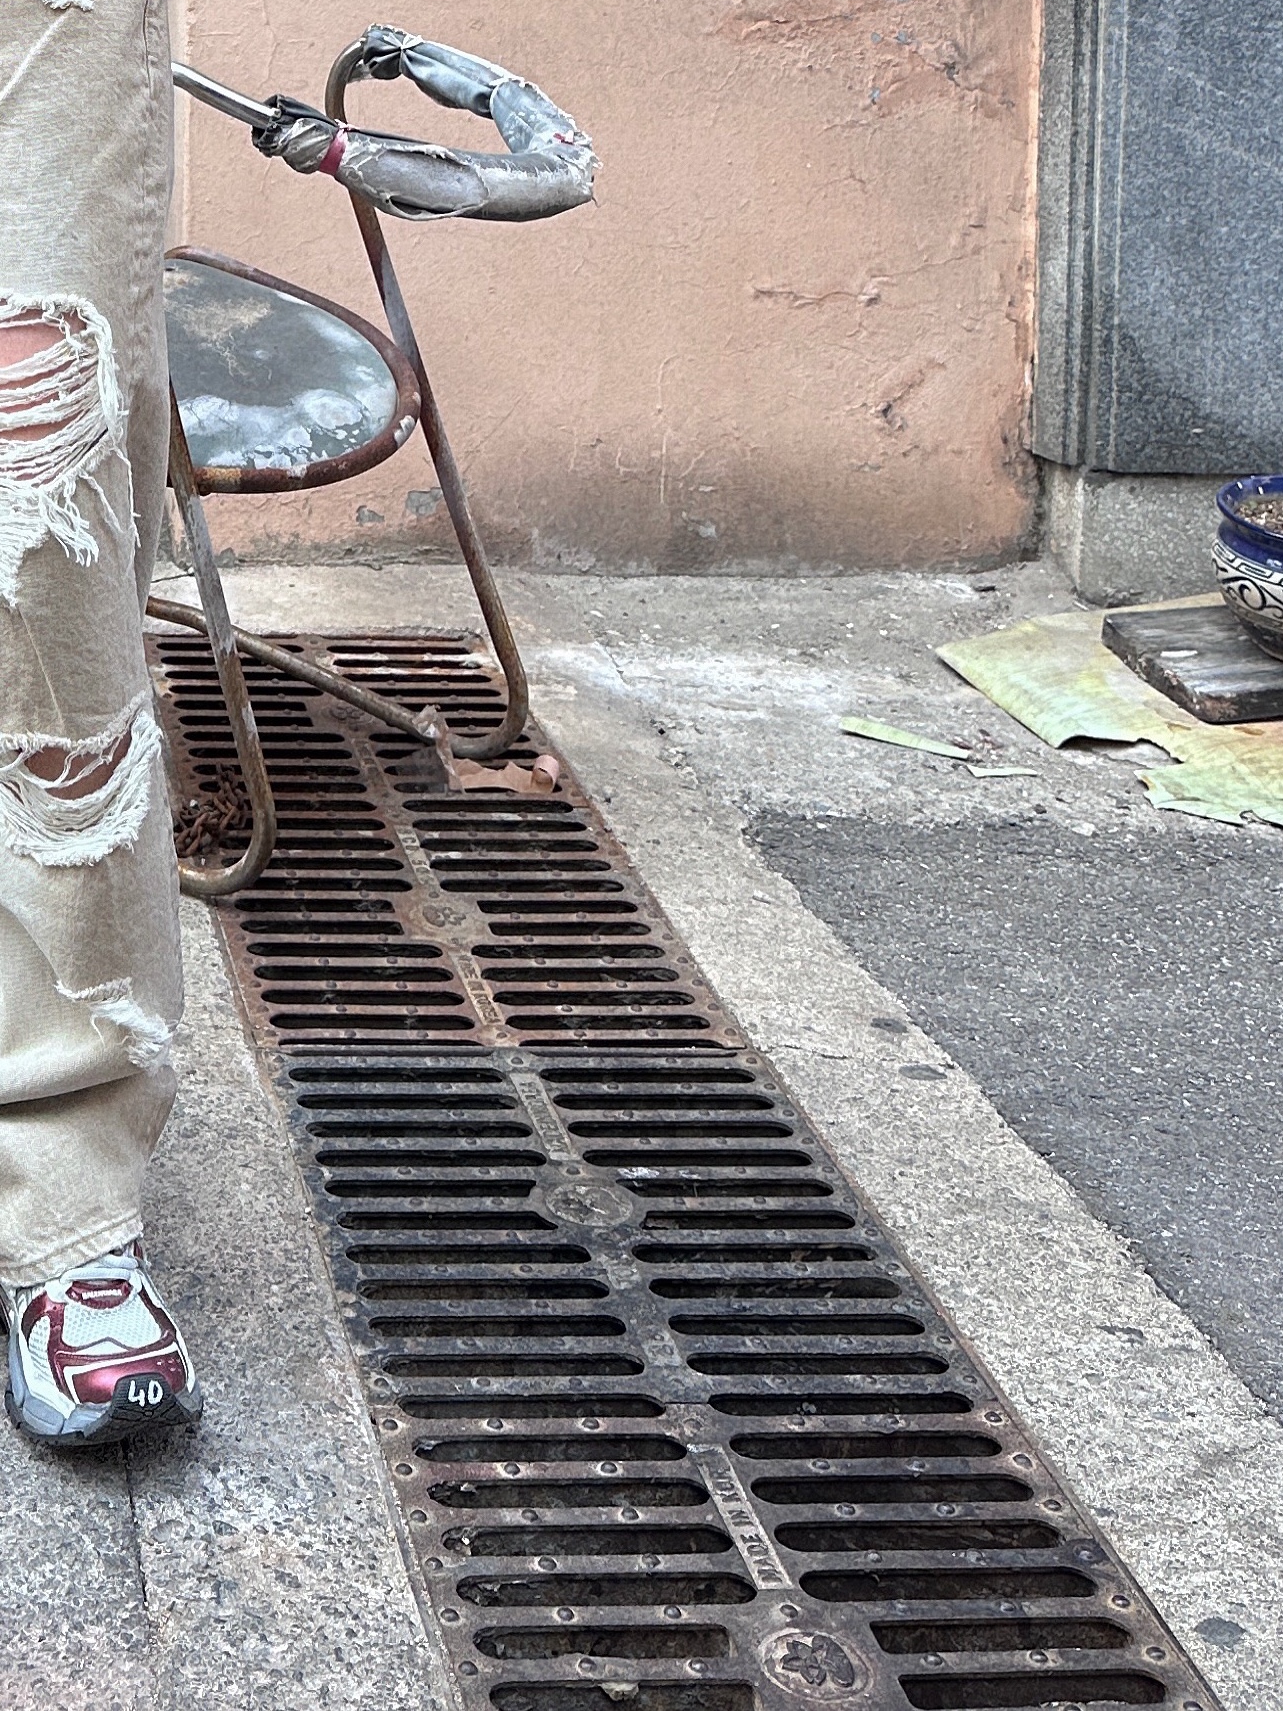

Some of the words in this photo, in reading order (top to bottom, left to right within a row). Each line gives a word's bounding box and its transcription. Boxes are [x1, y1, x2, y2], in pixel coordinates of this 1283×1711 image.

[127, 1379, 164, 1407] 40
[726, 1508, 755, 1528] IN
[740, 1533, 785, 1584] MADE
